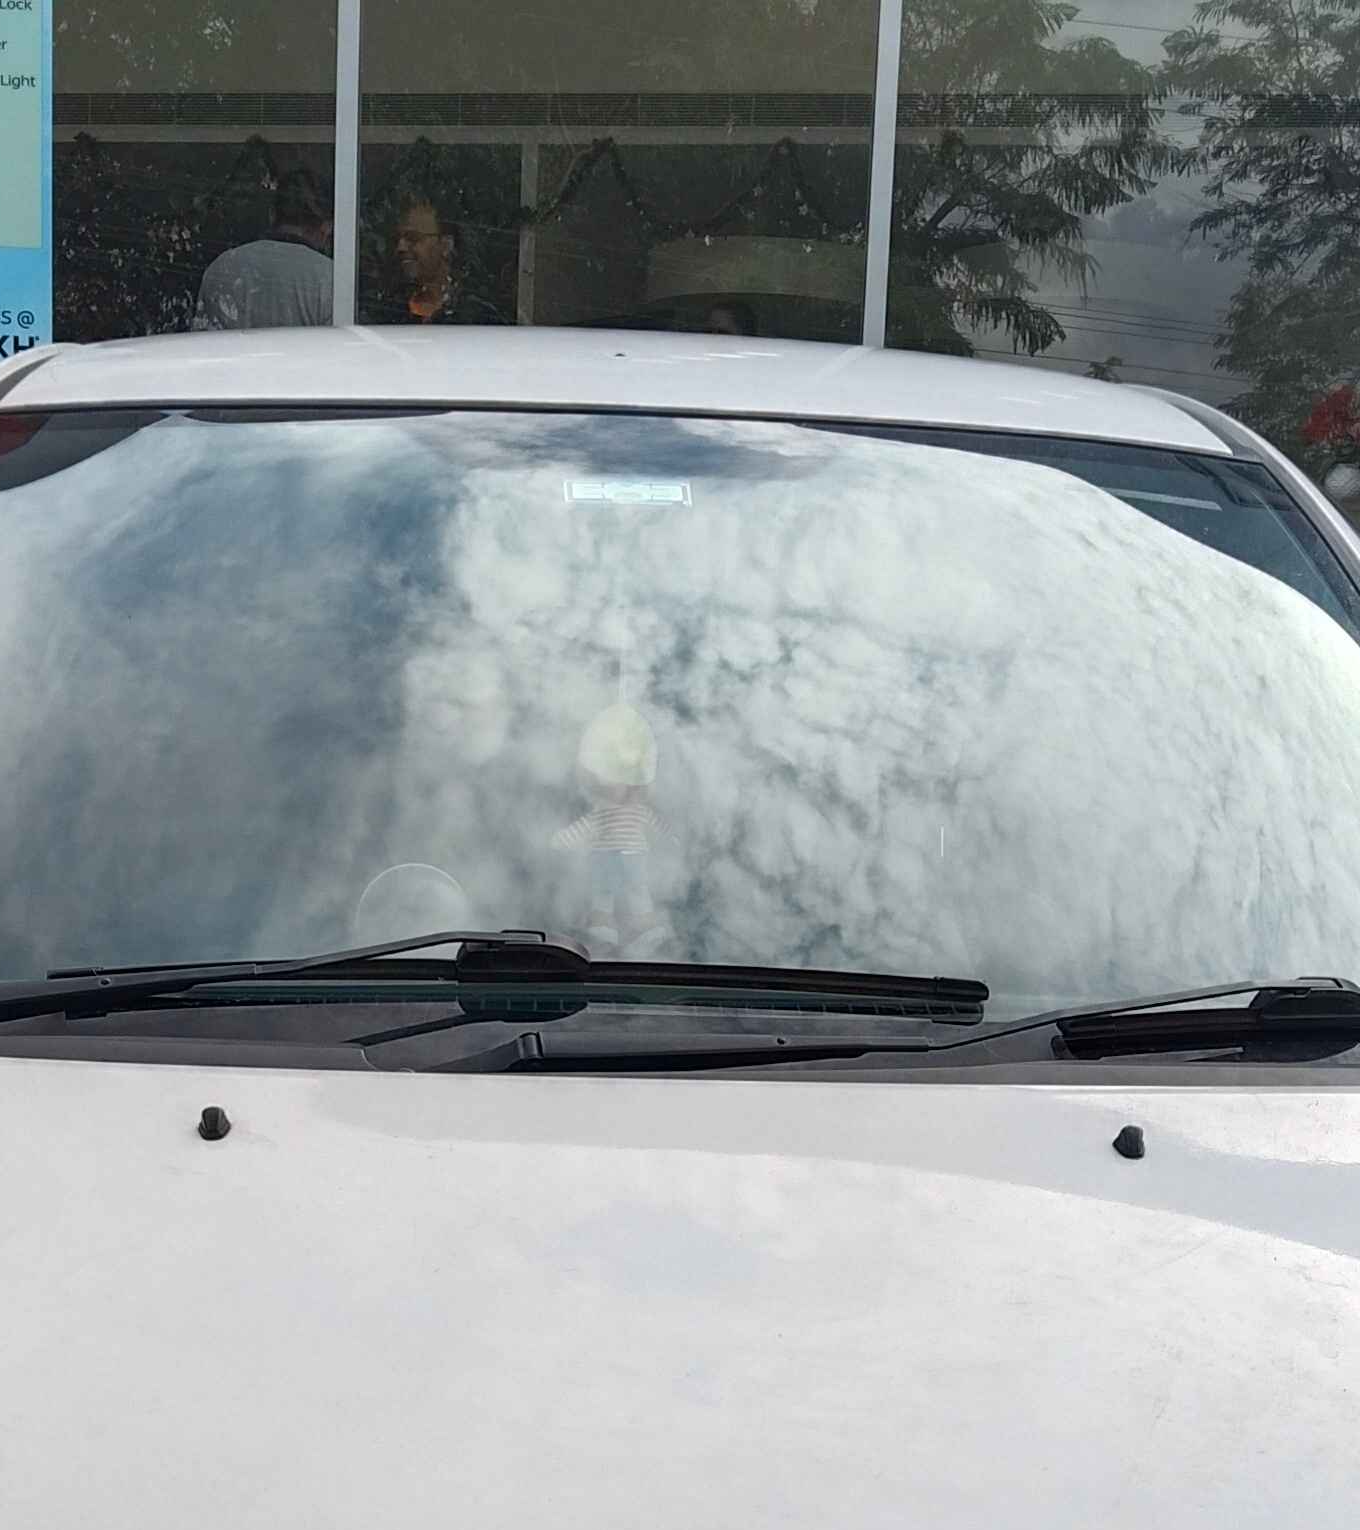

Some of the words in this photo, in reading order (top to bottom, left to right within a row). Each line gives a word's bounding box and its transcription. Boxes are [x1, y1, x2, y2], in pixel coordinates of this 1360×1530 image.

[0, 0, 33, 11] Lock
[0, 74, 36, 90] Light
[16, 310, 35, 330] @
